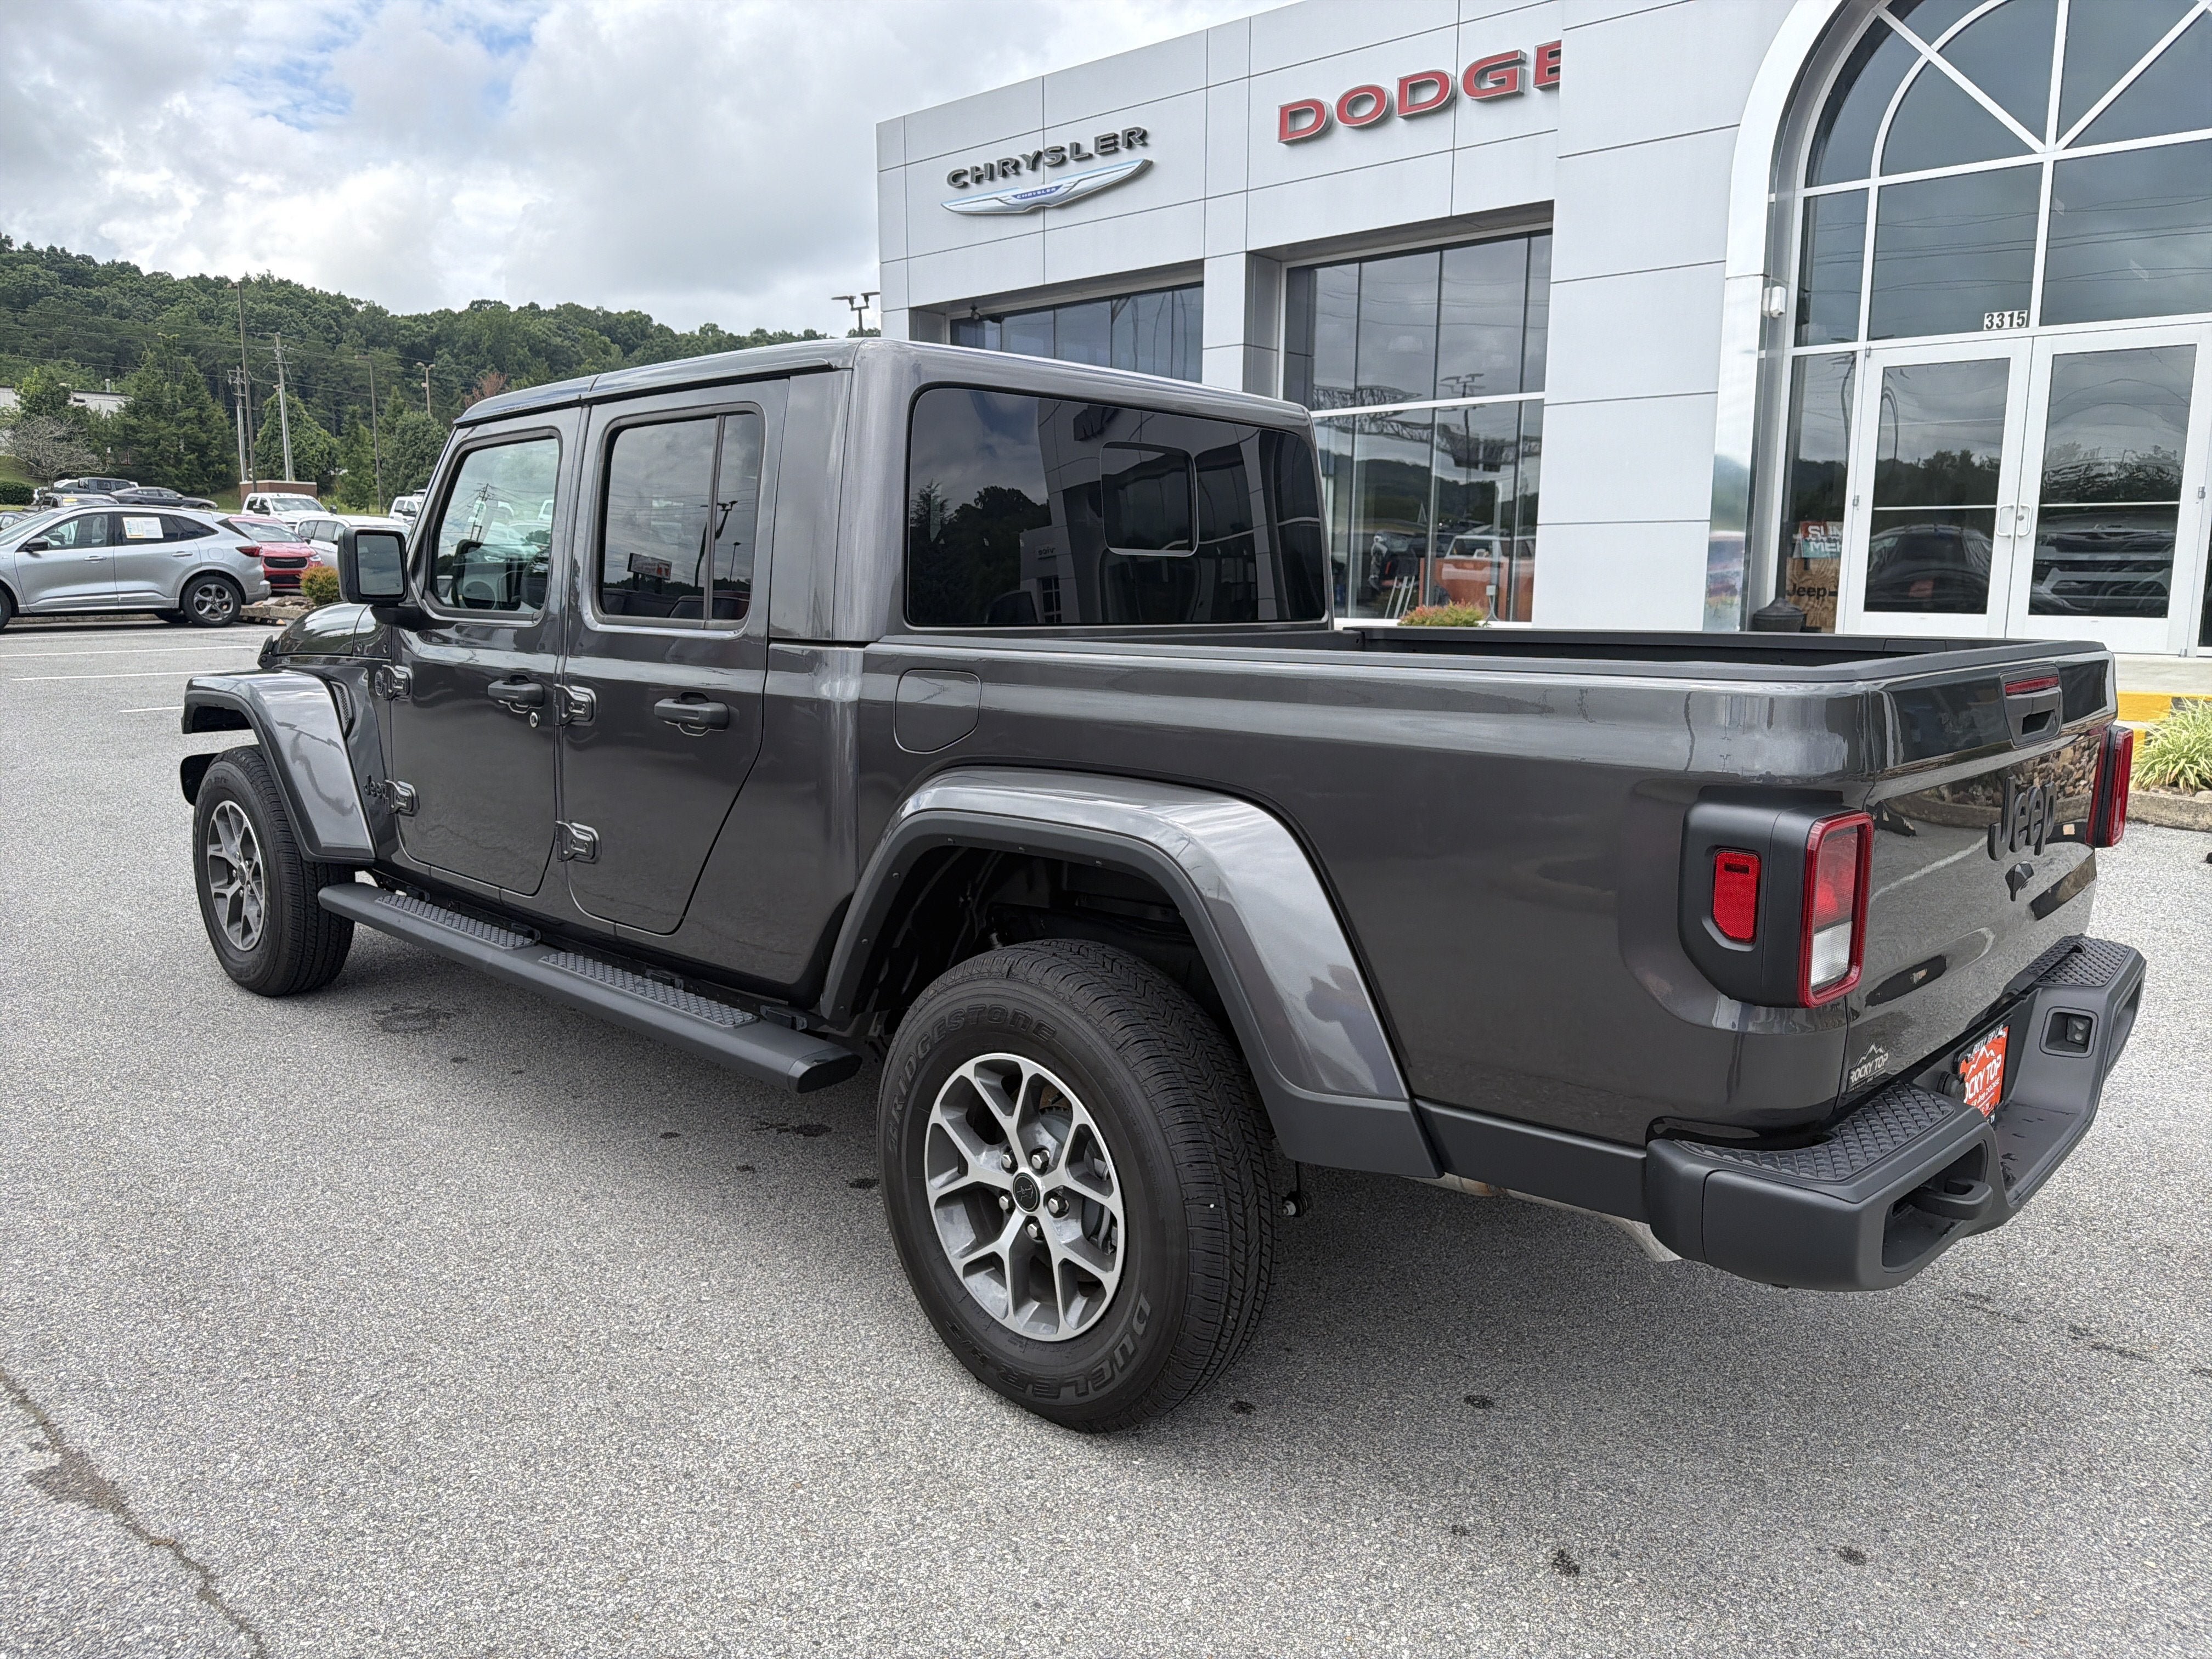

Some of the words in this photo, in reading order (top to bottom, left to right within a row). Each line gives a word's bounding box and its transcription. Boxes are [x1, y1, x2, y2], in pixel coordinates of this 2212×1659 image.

[1278, 40, 1562, 145] DODGE
[946, 127, 1149, 188] CHRYSLER
[1985, 311, 2025, 329] 3315
[1786, 583, 1827, 600] Jeep
[1987, 775, 2056, 861] Jeep
[888, 1003, 1057, 1154] BRIDGESTONE
[1850, 1060, 1874, 1084] ROCKY
[1875, 1052, 1888, 1071] TOP
[1987, 1054, 2002, 1085] TOP
[997, 1290, 1153, 1400] DUELER
